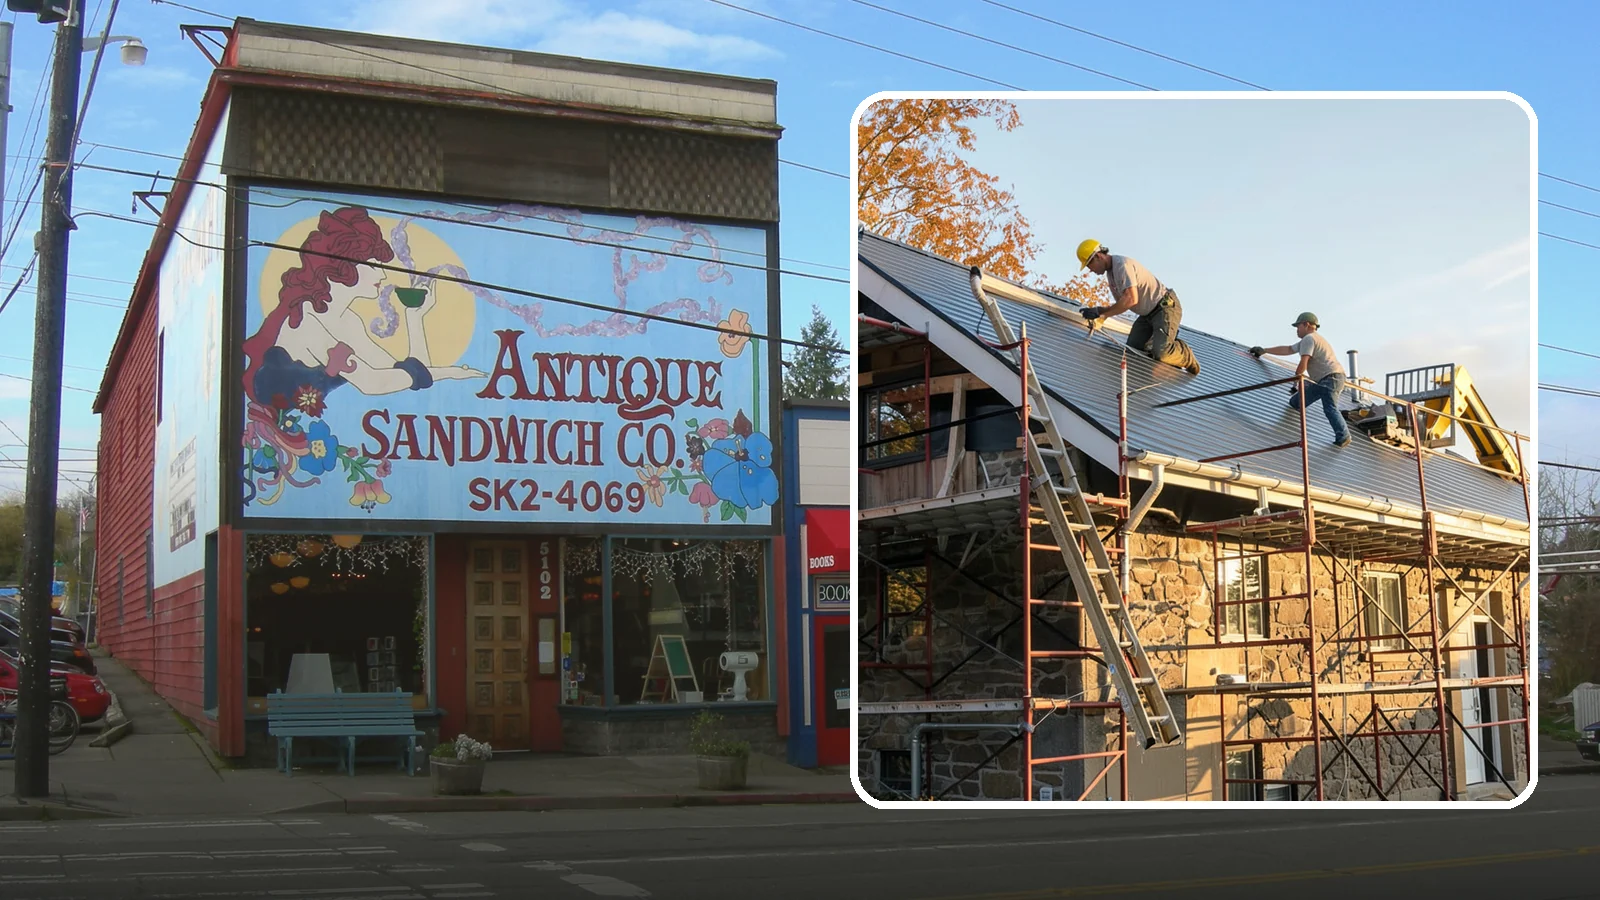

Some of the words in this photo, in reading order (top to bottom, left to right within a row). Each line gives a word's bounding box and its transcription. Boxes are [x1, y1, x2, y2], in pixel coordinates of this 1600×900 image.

[476, 329, 723, 420] ANTIQUE
[361, 408, 604, 467] SANDWICH
[617, 421, 685, 468] CO.
[469, 476, 645, 513] SK2-4069
[540, 541, 551, 600] 5102
[809, 555, 835, 569] BOOKS
